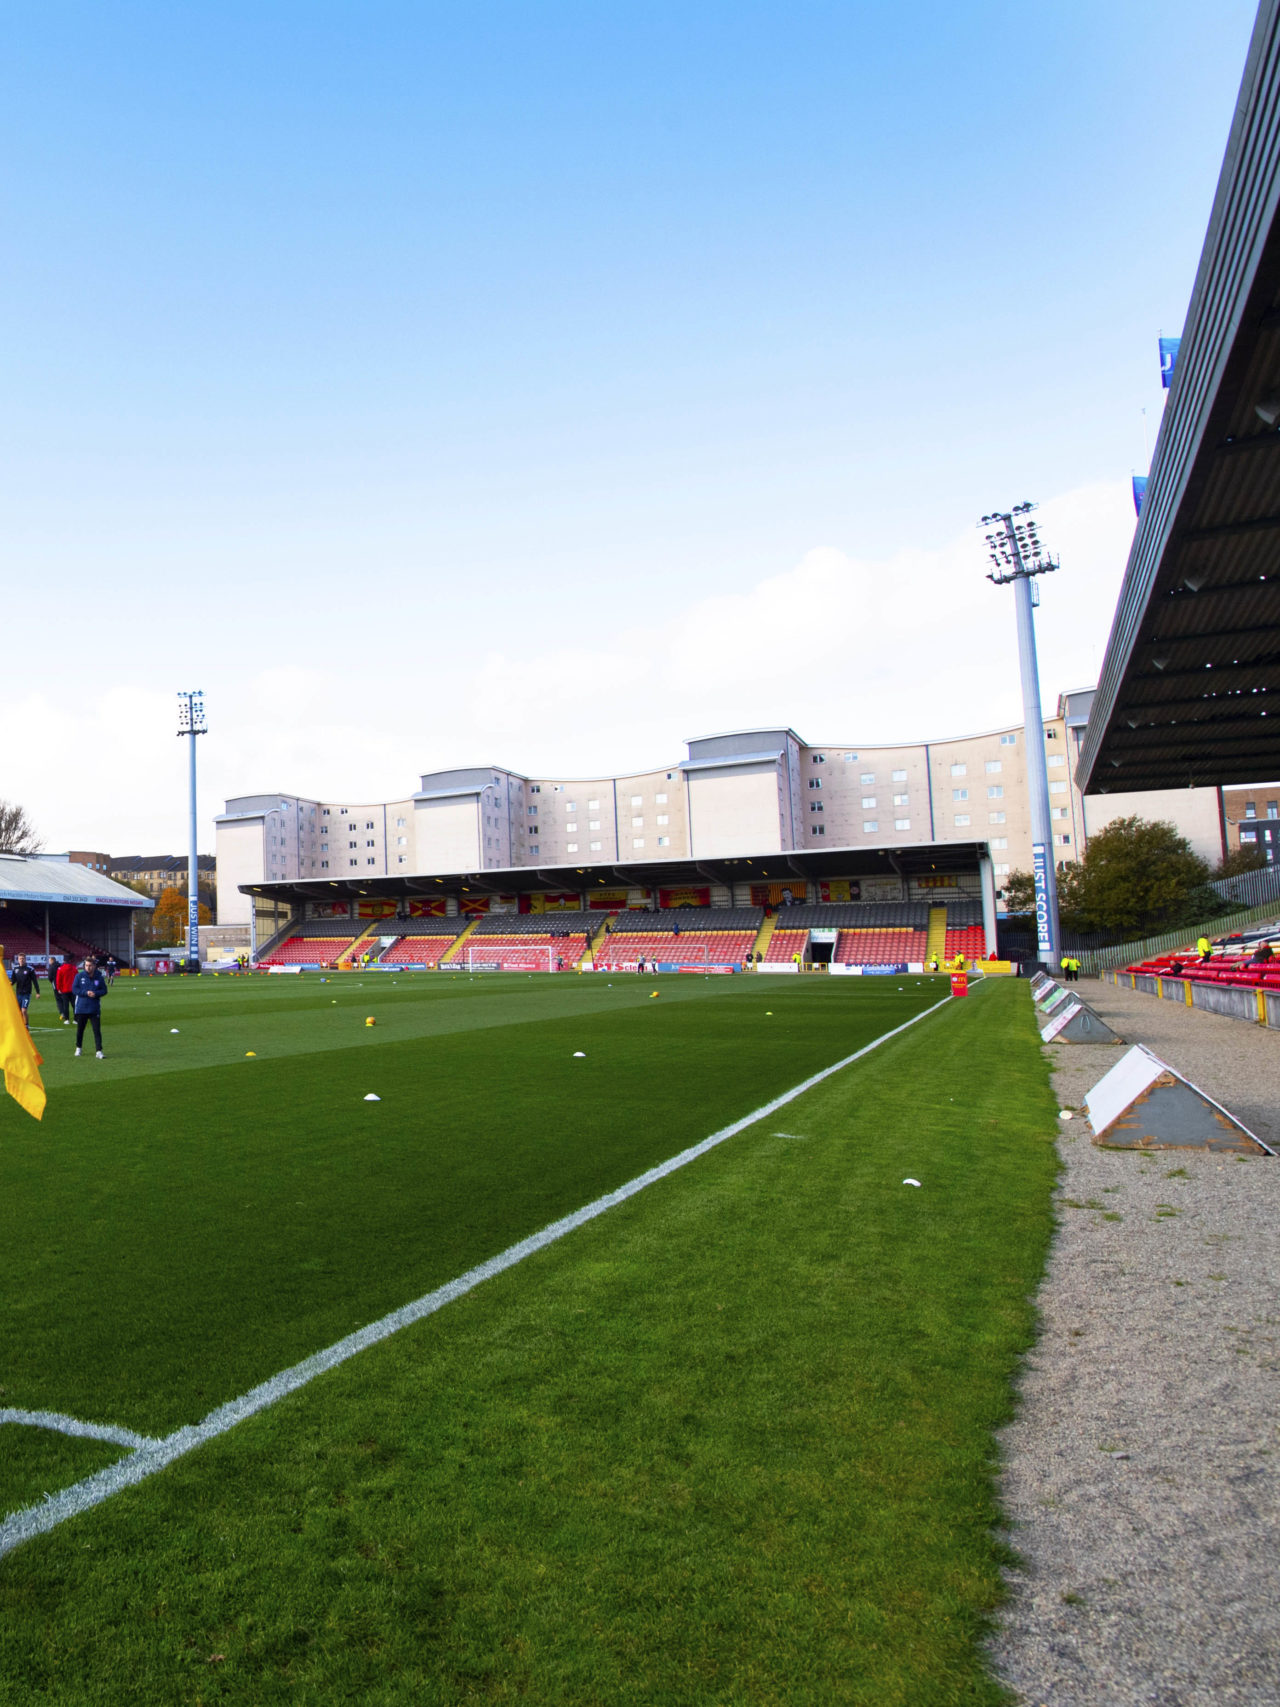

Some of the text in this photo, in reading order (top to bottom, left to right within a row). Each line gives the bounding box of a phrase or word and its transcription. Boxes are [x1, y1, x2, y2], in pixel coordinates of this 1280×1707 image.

[1033, 855, 1046, 889] JUST
[190, 902, 198, 923] JUST
[1035, 893, 1048, 940] SCORE
[190, 927, 198, 944] WIN
